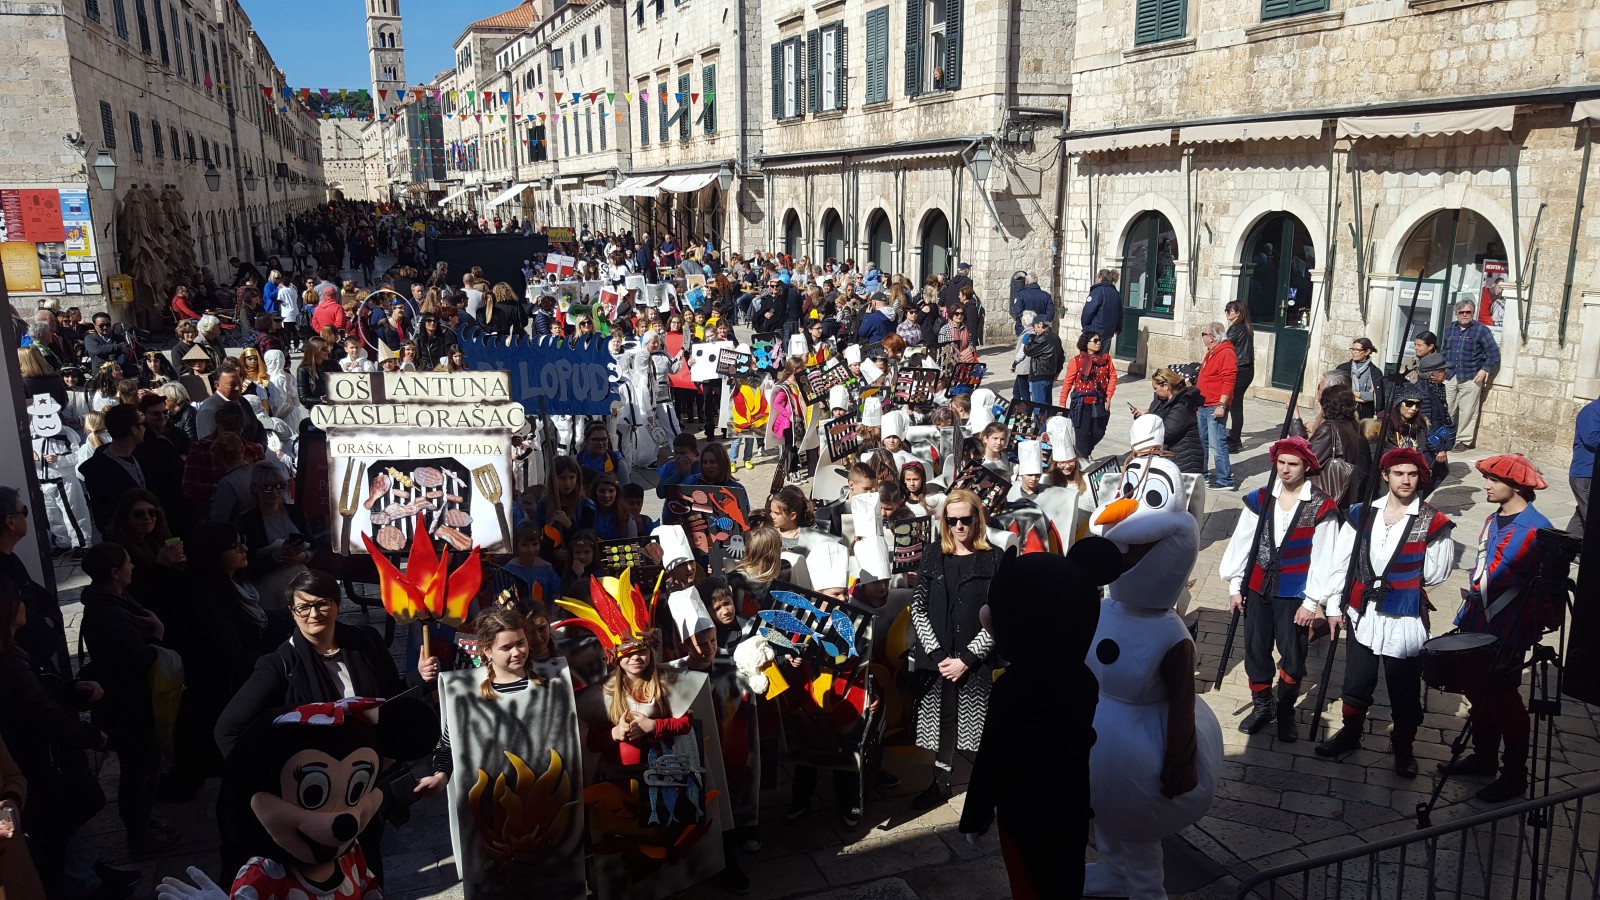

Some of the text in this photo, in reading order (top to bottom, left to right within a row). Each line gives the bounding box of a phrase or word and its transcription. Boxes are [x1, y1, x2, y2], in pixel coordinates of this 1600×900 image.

[335, 375, 509, 400] OŠ ANTUNA
[519, 359, 610, 402] LOPUD
[316, 403, 525, 428] MASLE ORAŠAC
[337, 441, 503, 455] ORAŠKA ROŠTILJADA
